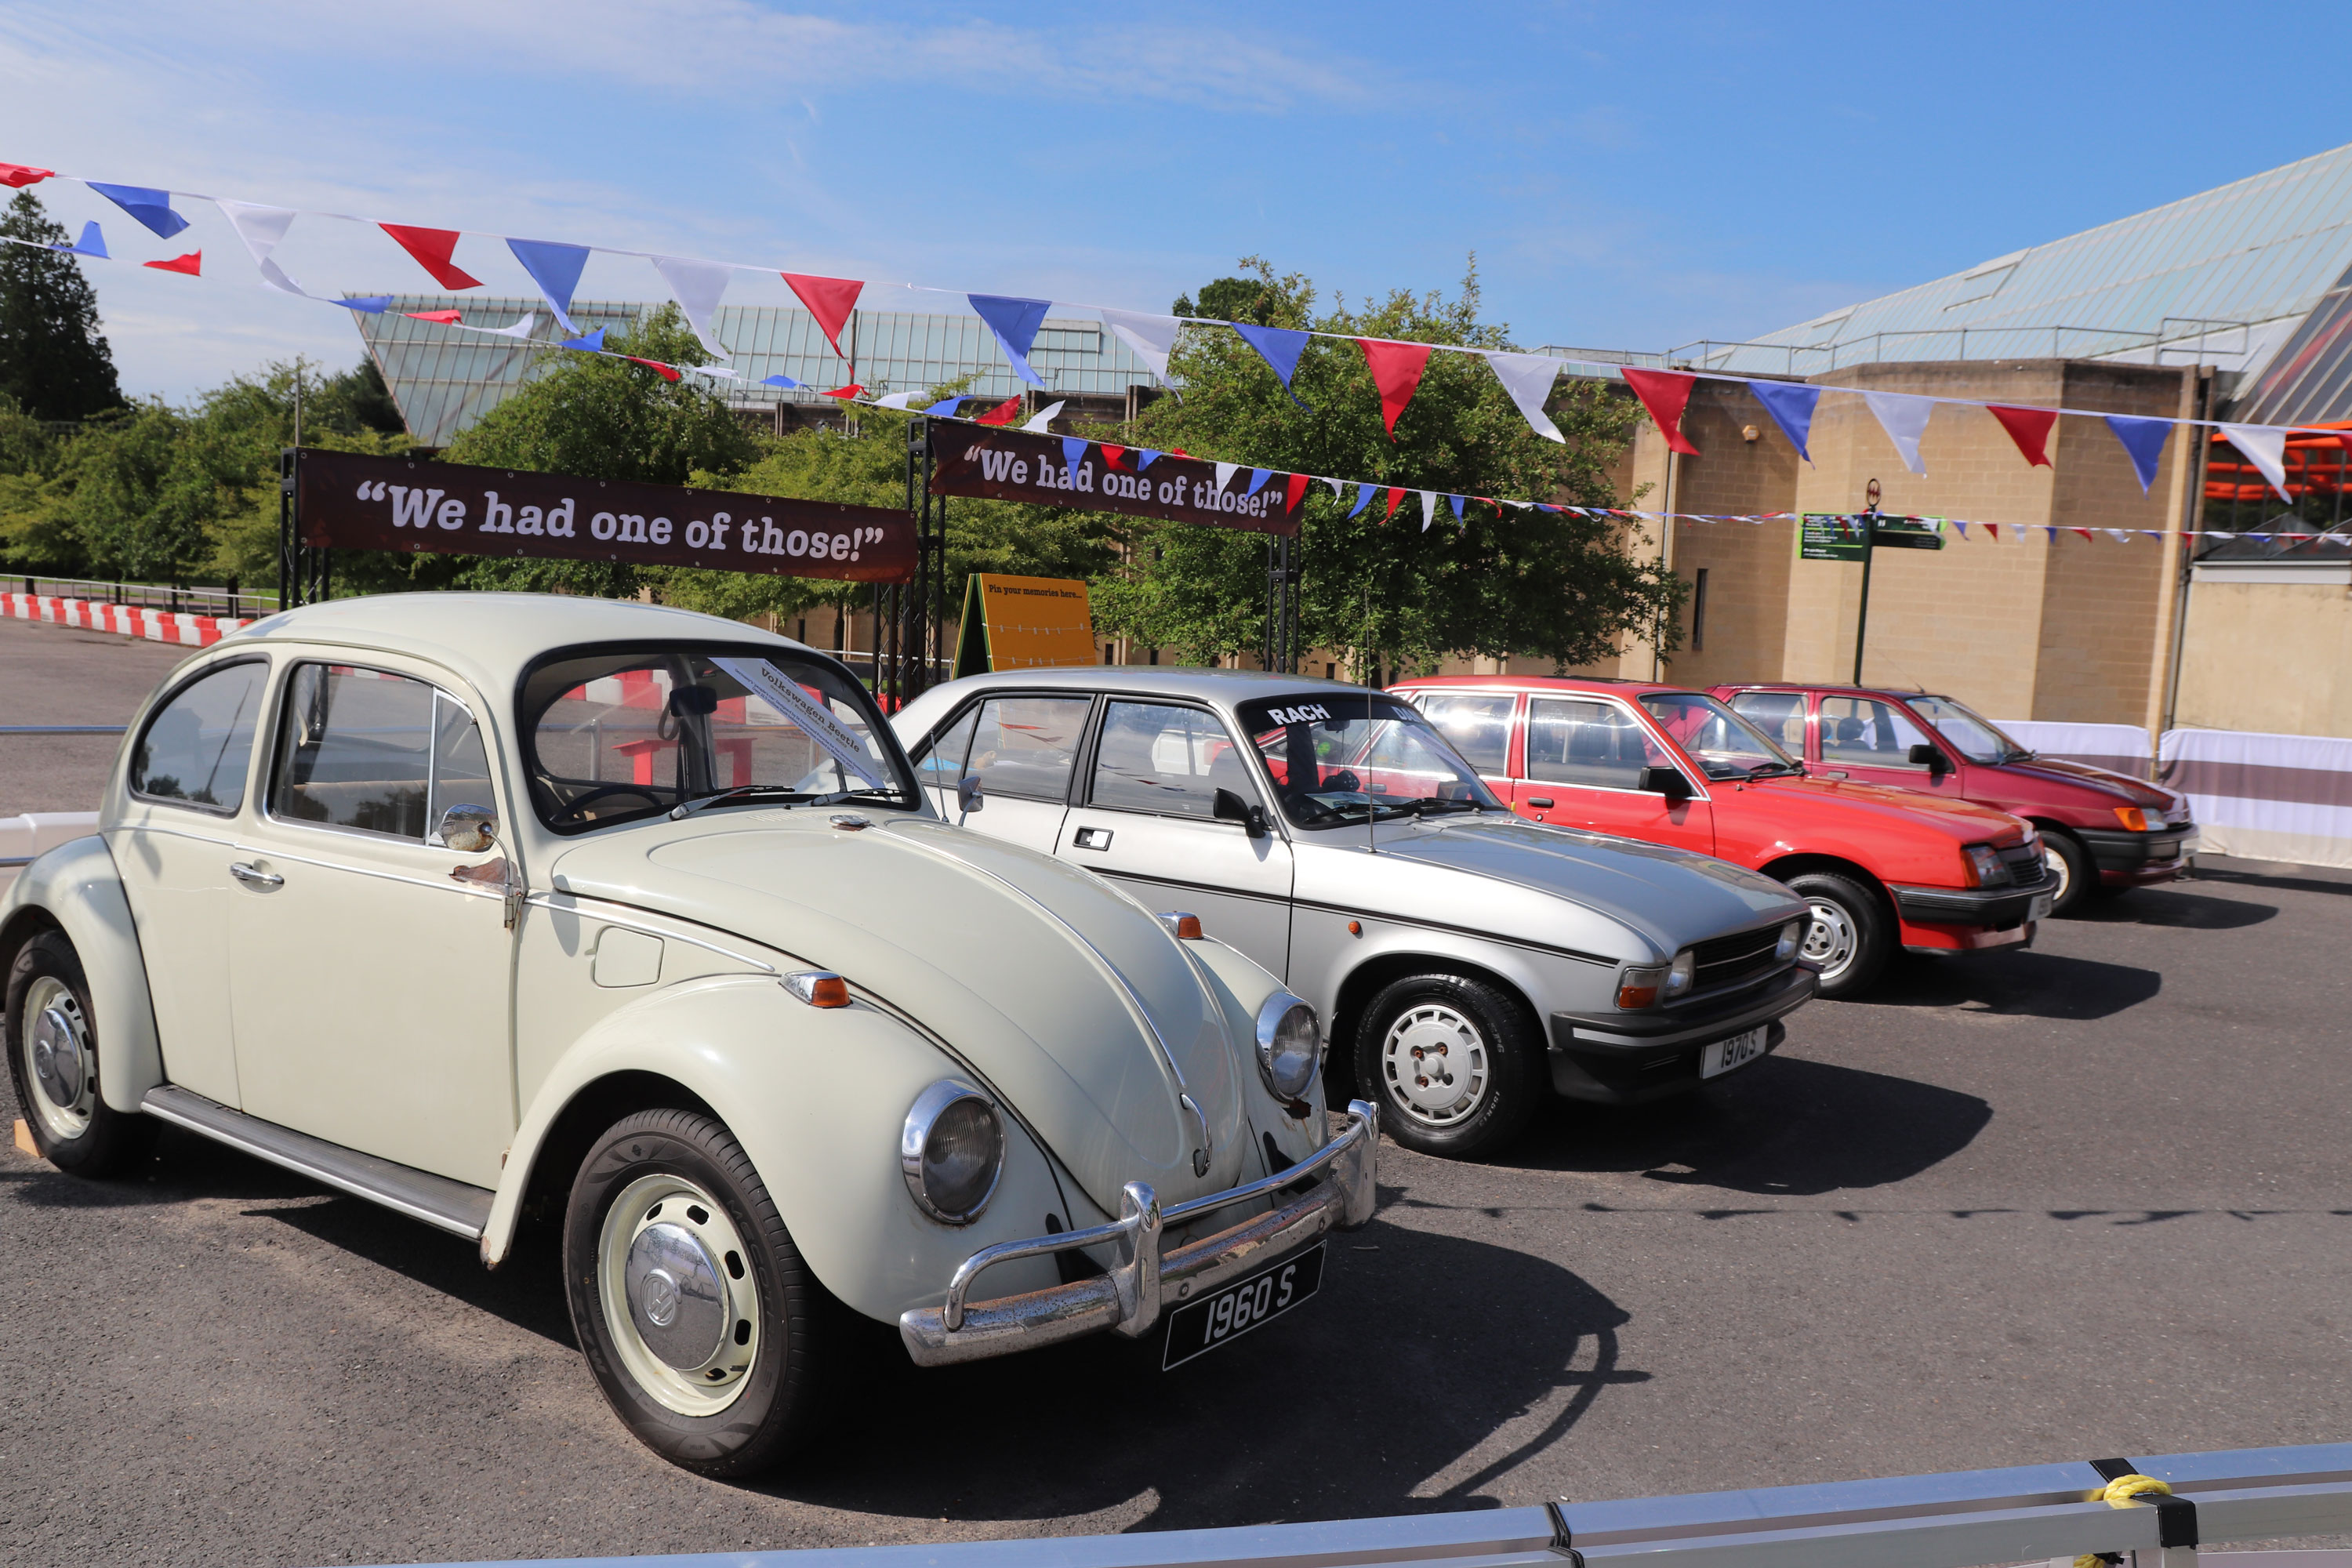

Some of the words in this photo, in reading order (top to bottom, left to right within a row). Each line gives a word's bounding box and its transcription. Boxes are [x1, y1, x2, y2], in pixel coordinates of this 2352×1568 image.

[964, 445, 1028, 484] “We
[1036, 454, 1094, 494] had
[1102, 473, 1151, 500] one
[1159, 477, 1186, 506] of
[1193, 480, 1283, 518] those!”
[357, 479, 463, 530] “We
[479, 491, 576, 538] had
[591, 511, 672, 545] one
[685, 511, 731, 551] of
[740, 517, 884, 563] those!”
[989, 584, 1002, 593] Pin
[1004, 586, 1022, 595] your
[1022, 588, 1059, 597] memories
[1060, 589, 1083, 598] here...
[761, 667, 825, 724] Volkswagen
[827, 720, 860, 753] Beetle
[770, 684, 790, 702] Germany
[1267, 703, 1331, 726] RACH
[1721, 1033, 1749, 1069] 1970
[1749, 1029, 1758, 1055] S
[1204, 1276, 1273, 1345] 1960
[1276, 1265, 1296, 1308] S
